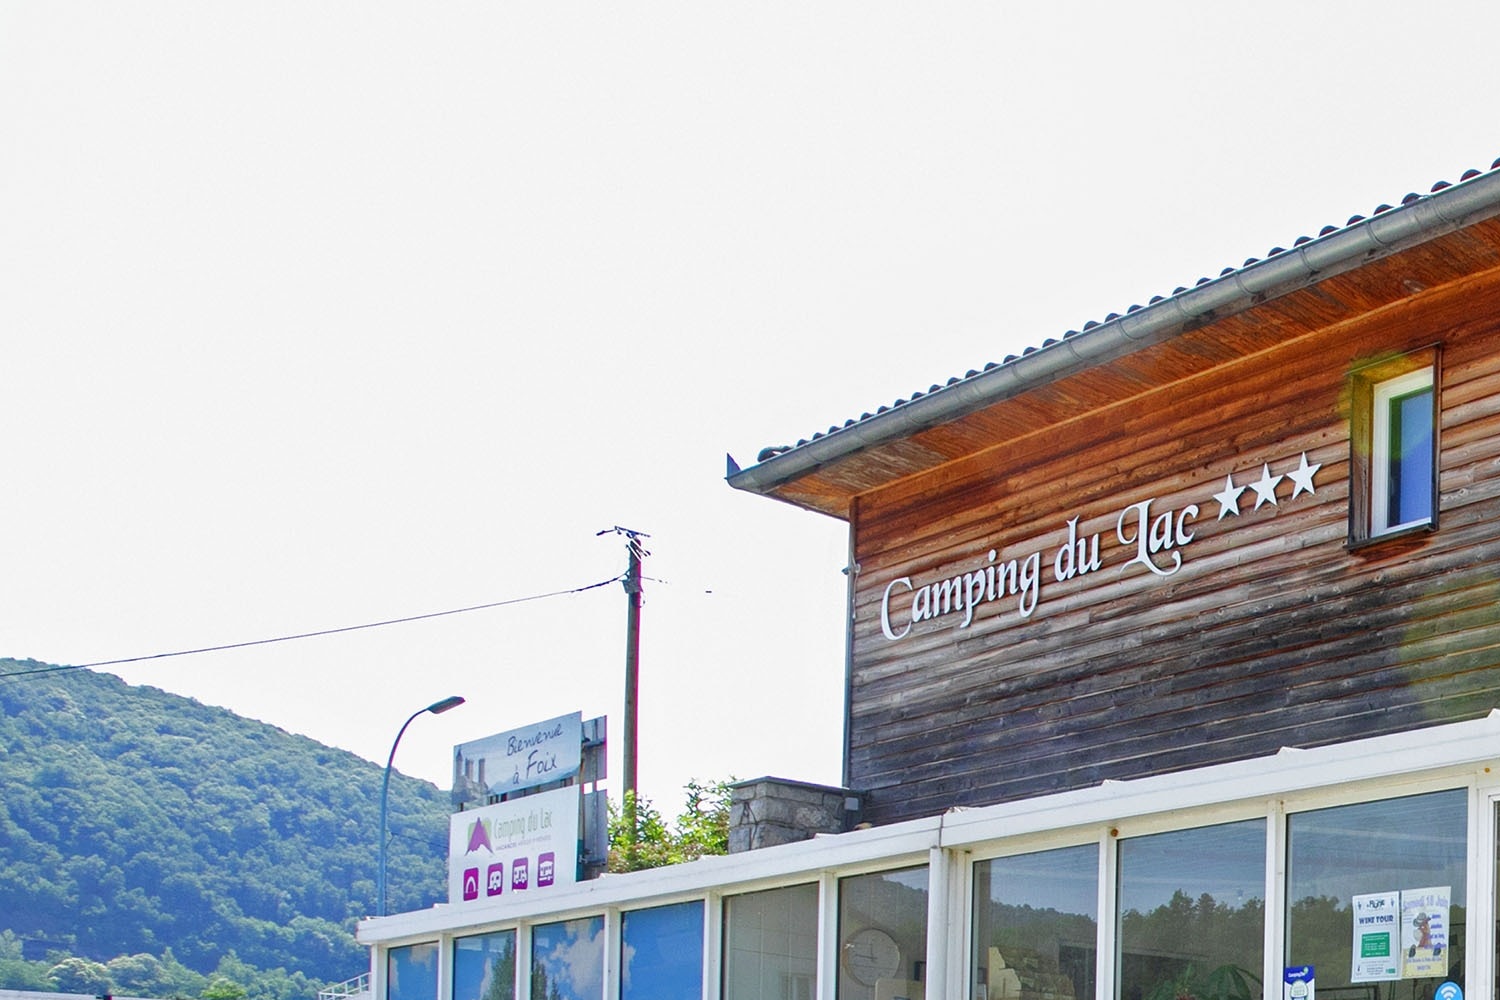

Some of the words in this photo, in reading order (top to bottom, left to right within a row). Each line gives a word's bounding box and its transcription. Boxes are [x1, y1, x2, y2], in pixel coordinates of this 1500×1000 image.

[880, 548, 1041, 641] Camping
[1054, 515, 1102, 582] du
[1116, 498, 1200, 577] Lac
[507, 723, 563, 756] Bienvenue
[512, 765, 520, 785] à
[526, 749, 558, 779] Foix
[493, 814, 526, 842] Camping
[527, 809, 538, 833] du
[540, 807, 553, 829] Lac
[1376, 914, 1394, 923] TOUR
